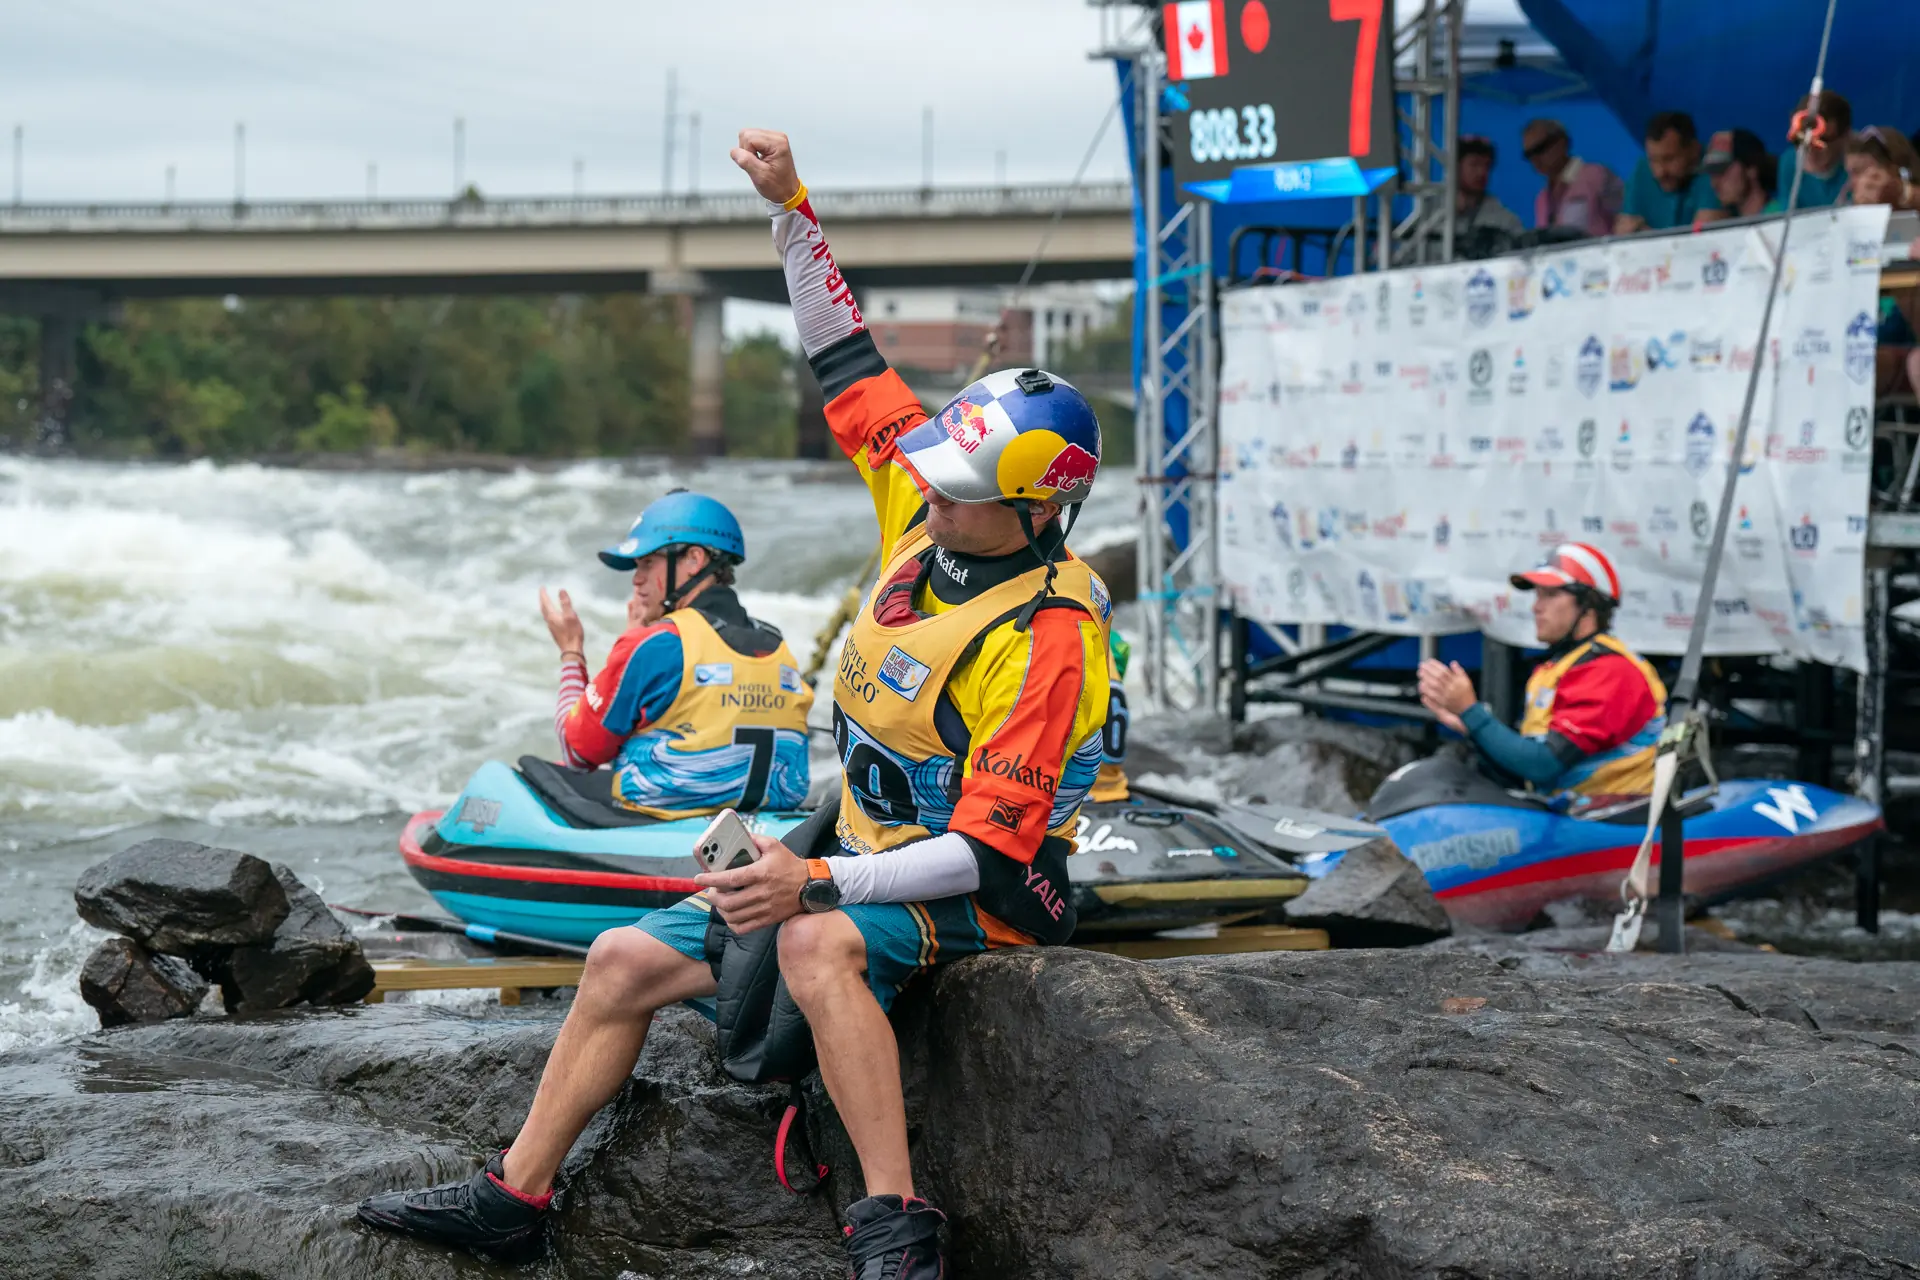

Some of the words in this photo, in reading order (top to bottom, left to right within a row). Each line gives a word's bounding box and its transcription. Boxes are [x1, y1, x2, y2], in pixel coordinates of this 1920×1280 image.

[1329, 0, 1384, 157] 7
[1189, 103, 1278, 163] 808.33
[943, 407, 961, 435] Red
[952, 427, 980, 454] Bull
[721, 692, 787, 710] INDIGO
[737, 683, 773, 693] HOTEL
[733, 726, 776, 812] 7
[1024, 866, 1066, 922] YALE
